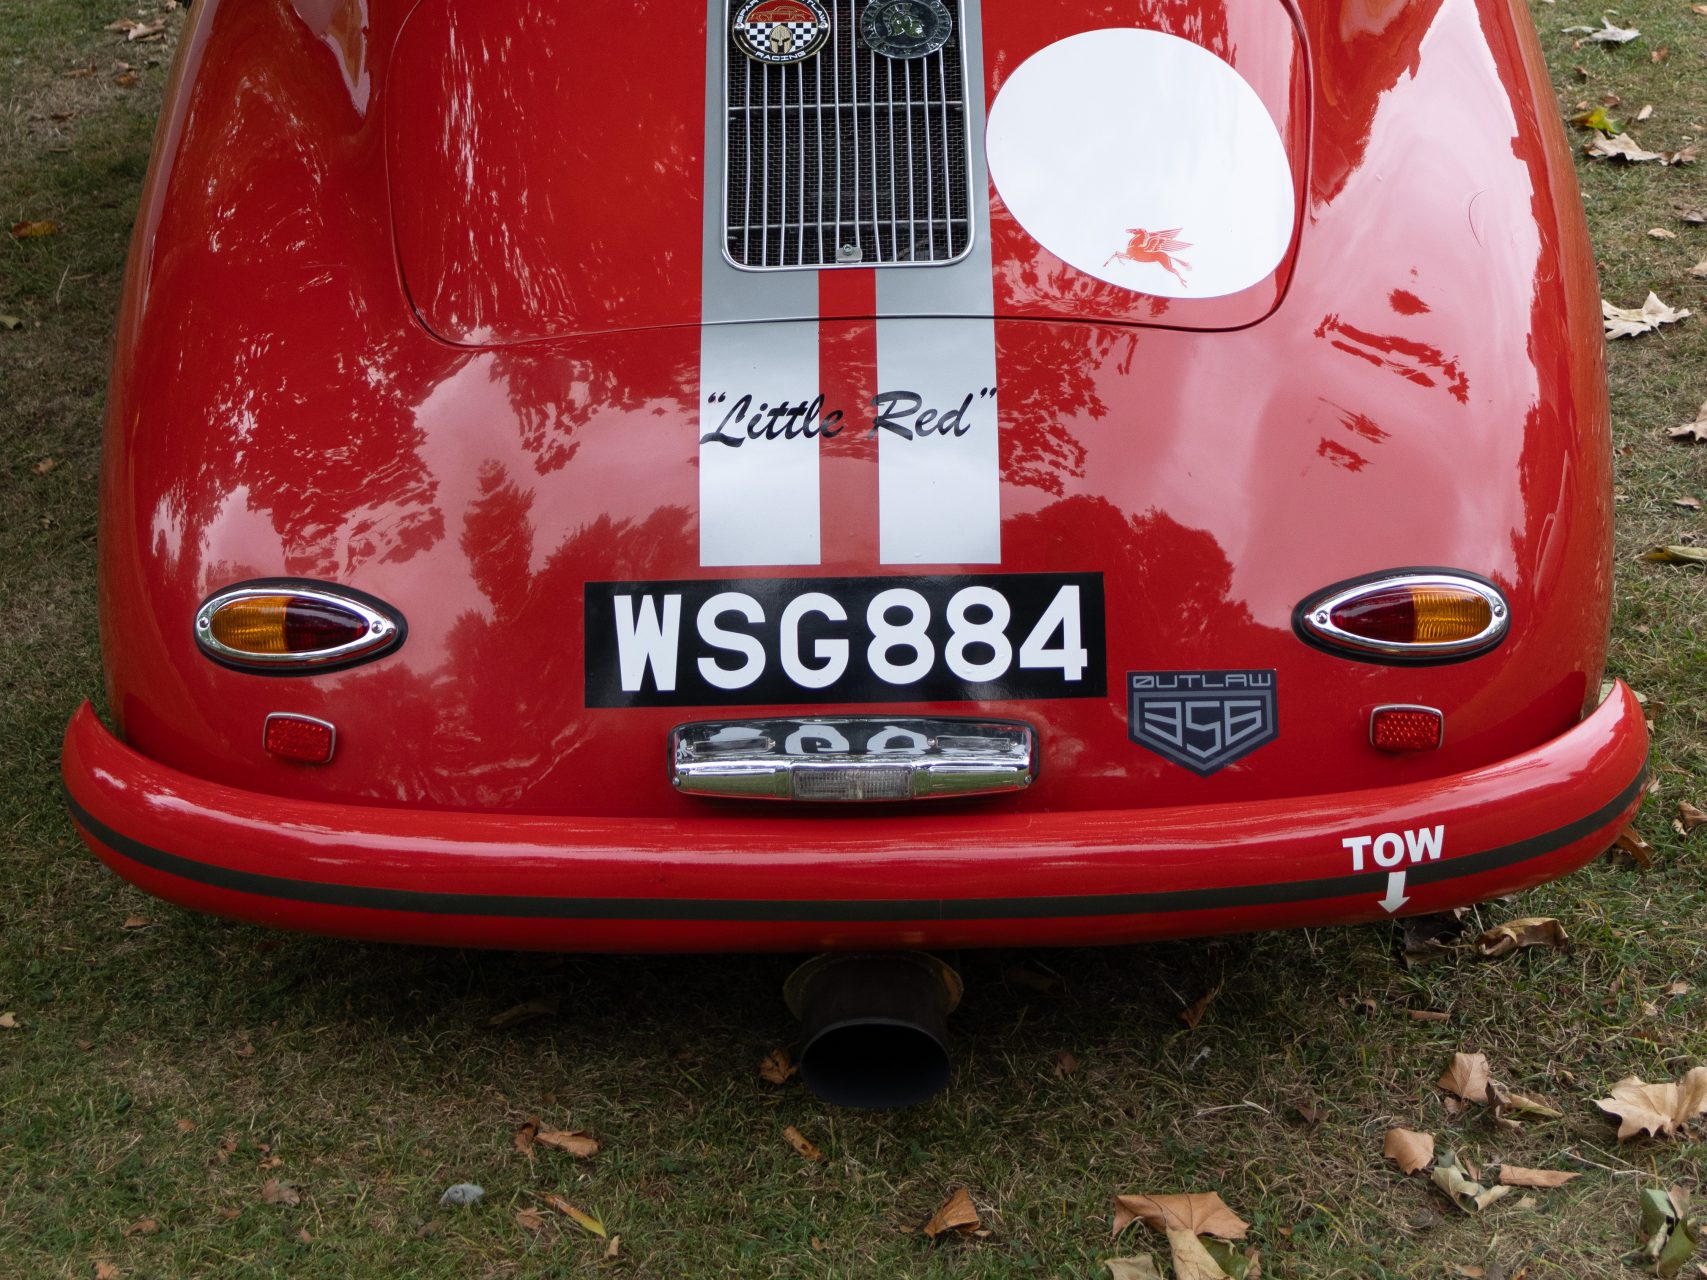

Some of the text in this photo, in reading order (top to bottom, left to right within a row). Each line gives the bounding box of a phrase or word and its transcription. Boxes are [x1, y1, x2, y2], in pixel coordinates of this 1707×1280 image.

[755, 50, 806, 60] RACING
[613, 584, 1088, 692] WSG884
[1144, 700, 1262, 758] 356
[1342, 824, 1445, 871] TOW
